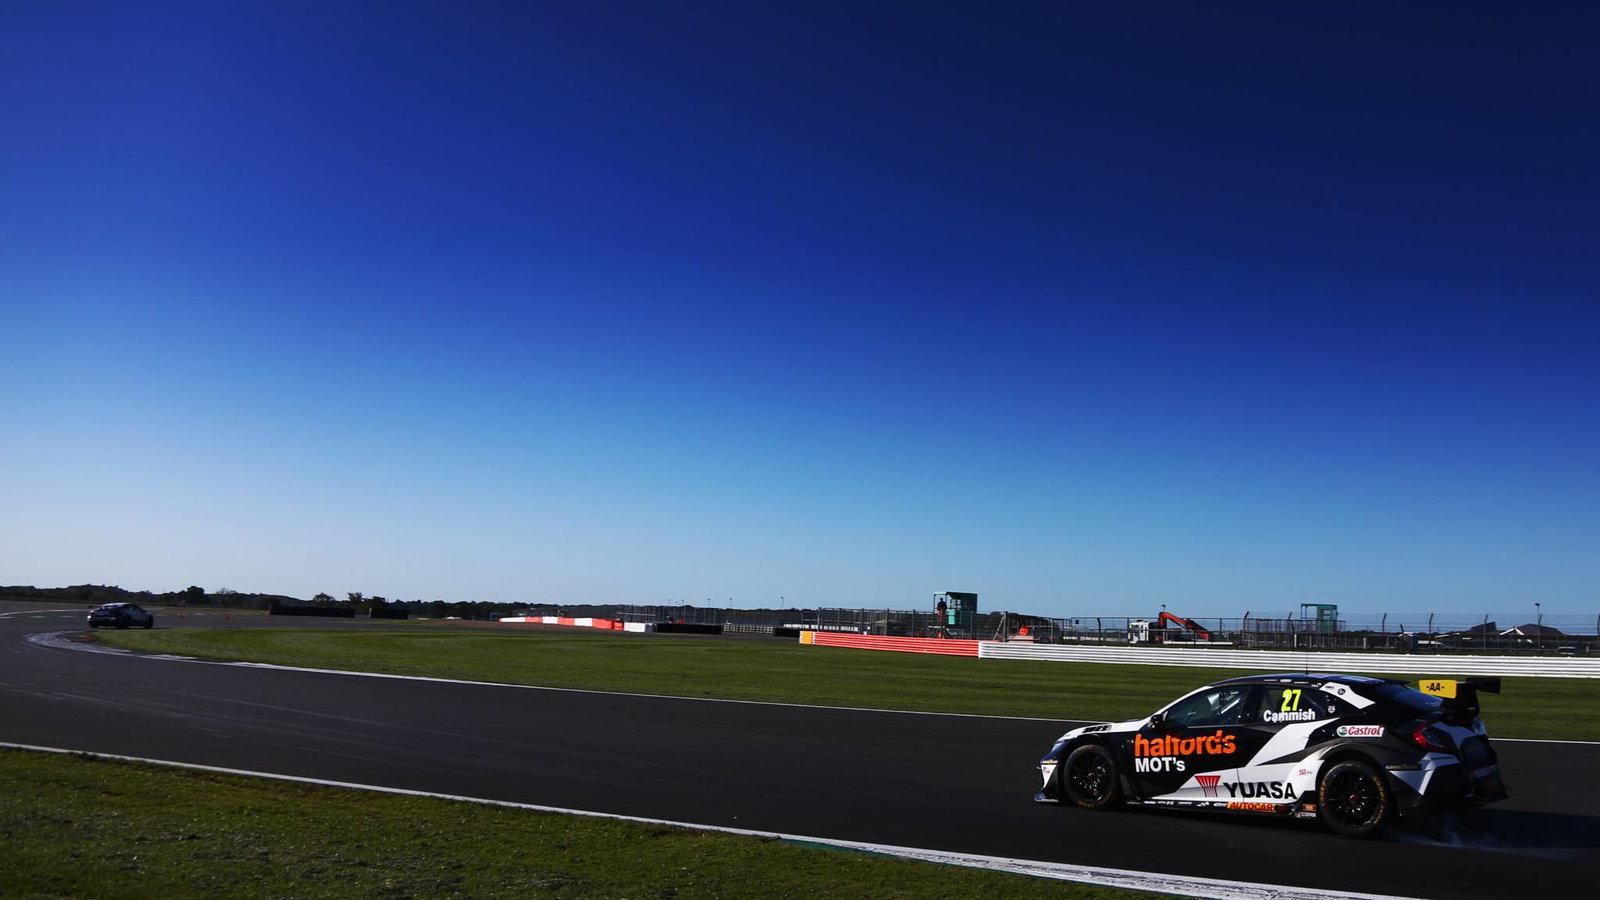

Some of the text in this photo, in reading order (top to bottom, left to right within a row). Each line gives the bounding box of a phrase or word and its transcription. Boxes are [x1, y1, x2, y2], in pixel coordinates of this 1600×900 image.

[1281, 689, 1301, 711] 27
[1263, 708, 1316, 722] Cammish
[1348, 726, 1382, 736] Castrol
[1135, 730, 1236, 757] halfords
[1135, 757, 1186, 772] MOT's
[1223, 782, 1298, 800] YUASA
[1231, 802, 1274, 811] AUTOCAR
